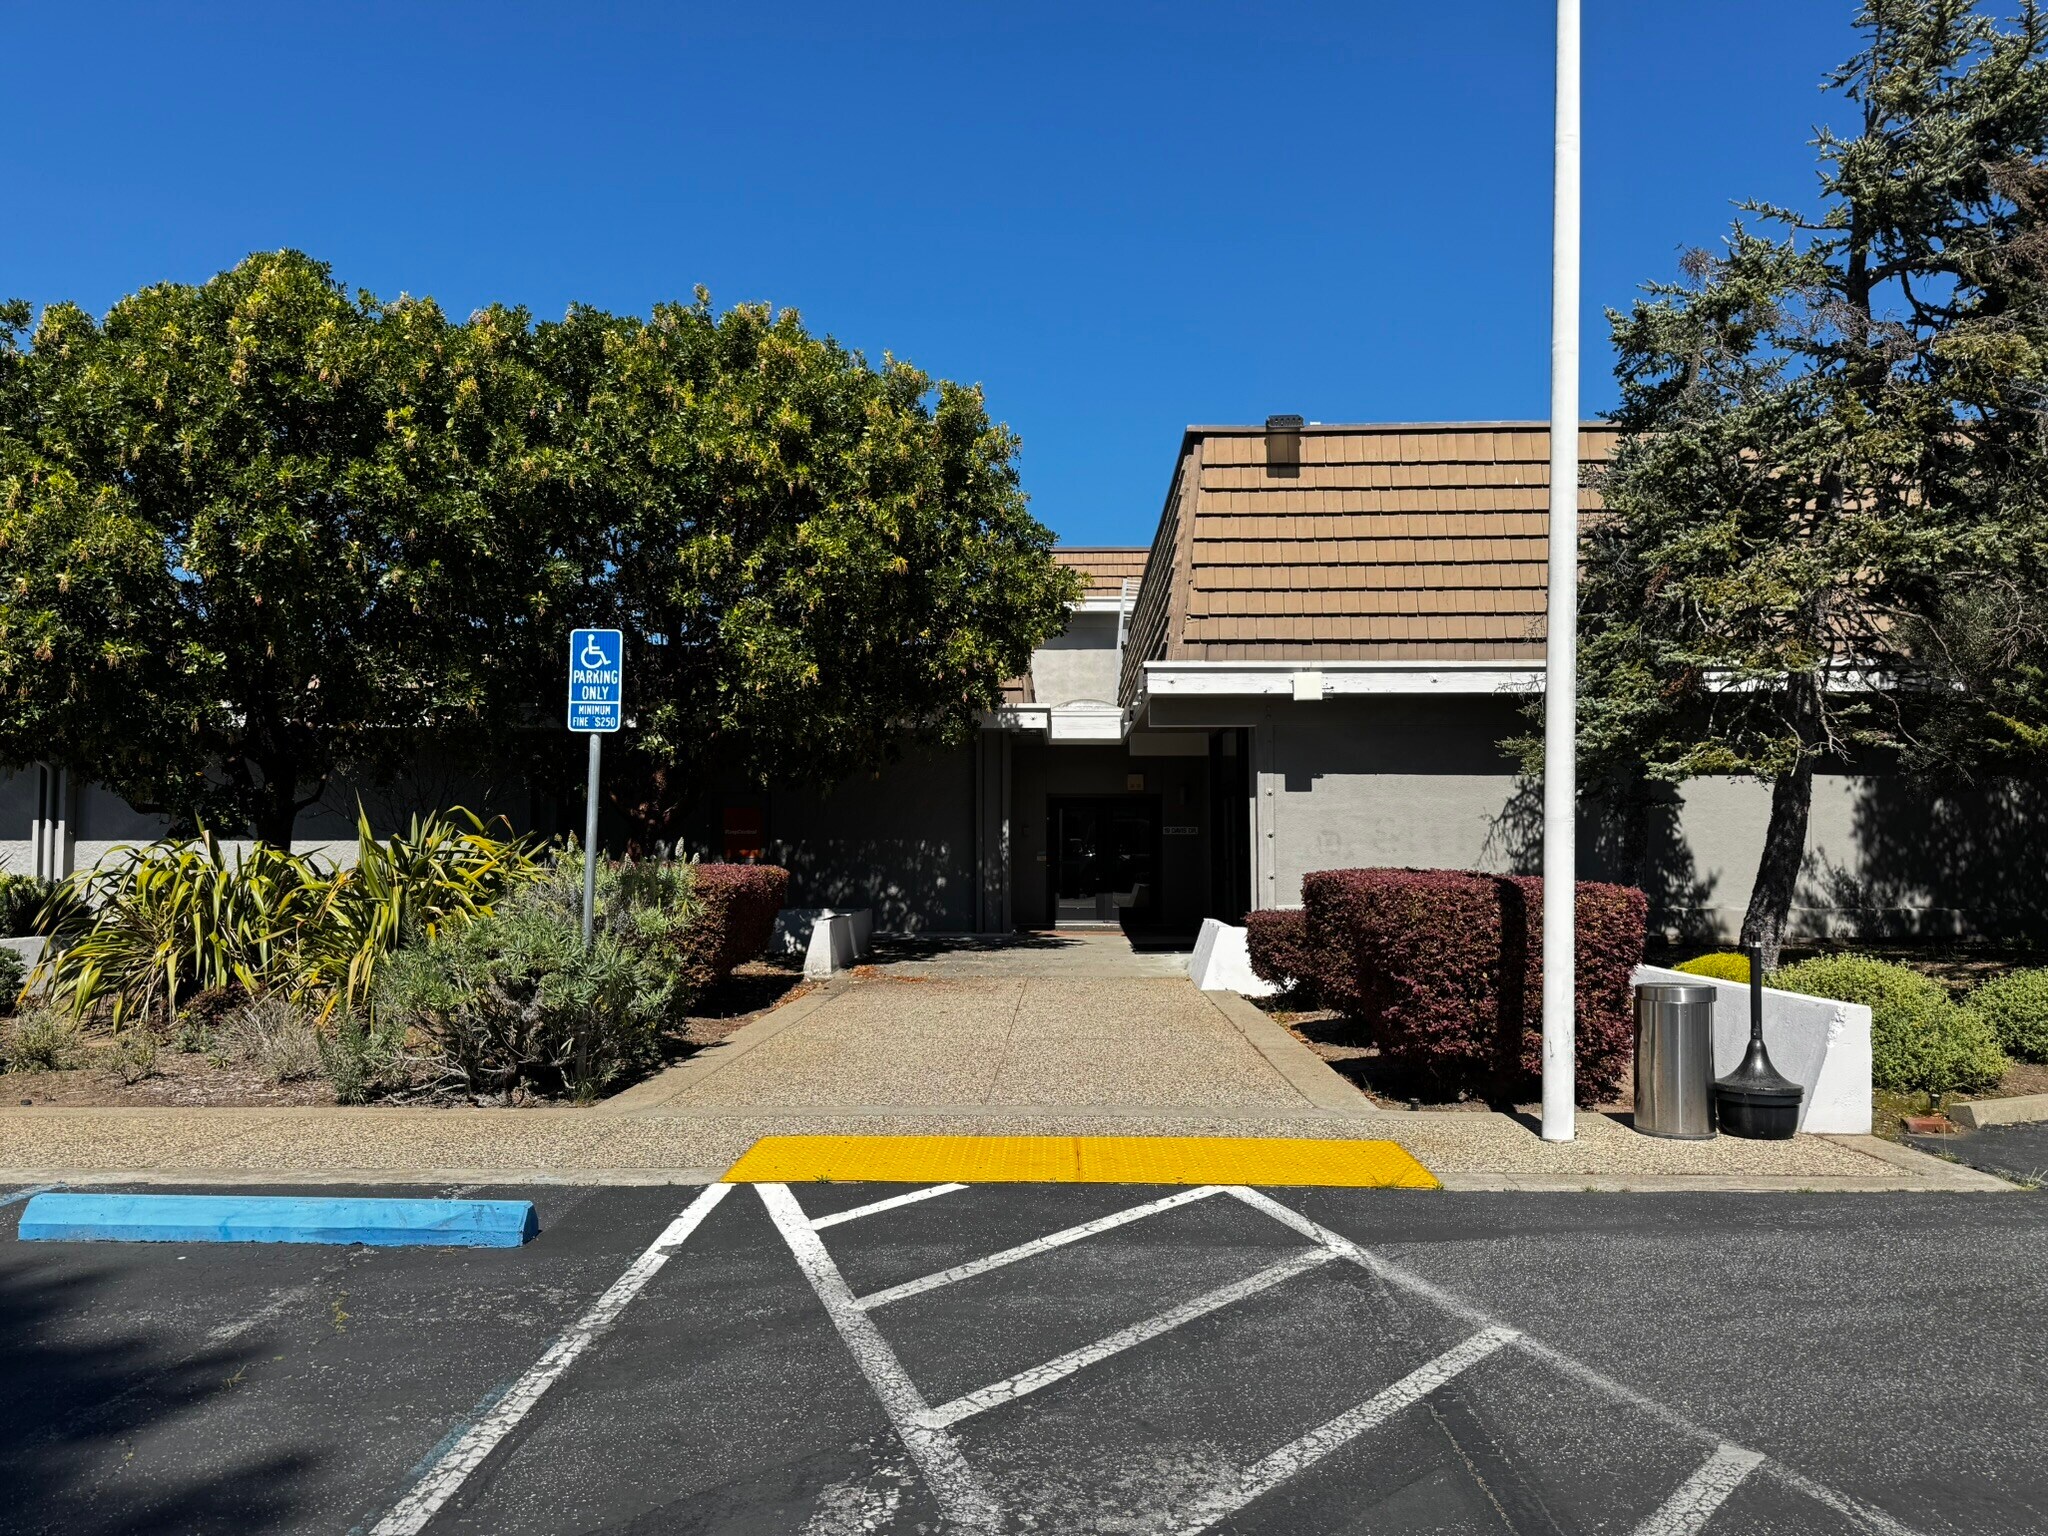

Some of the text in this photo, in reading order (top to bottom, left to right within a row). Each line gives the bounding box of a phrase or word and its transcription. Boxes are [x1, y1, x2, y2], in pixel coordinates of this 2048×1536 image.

[573, 670, 618, 684] PARKING
[582, 686, 609, 700] ONLY
[579, 705, 611, 715] MINIMUM
[573, 717, 615, 727] FINE $250
